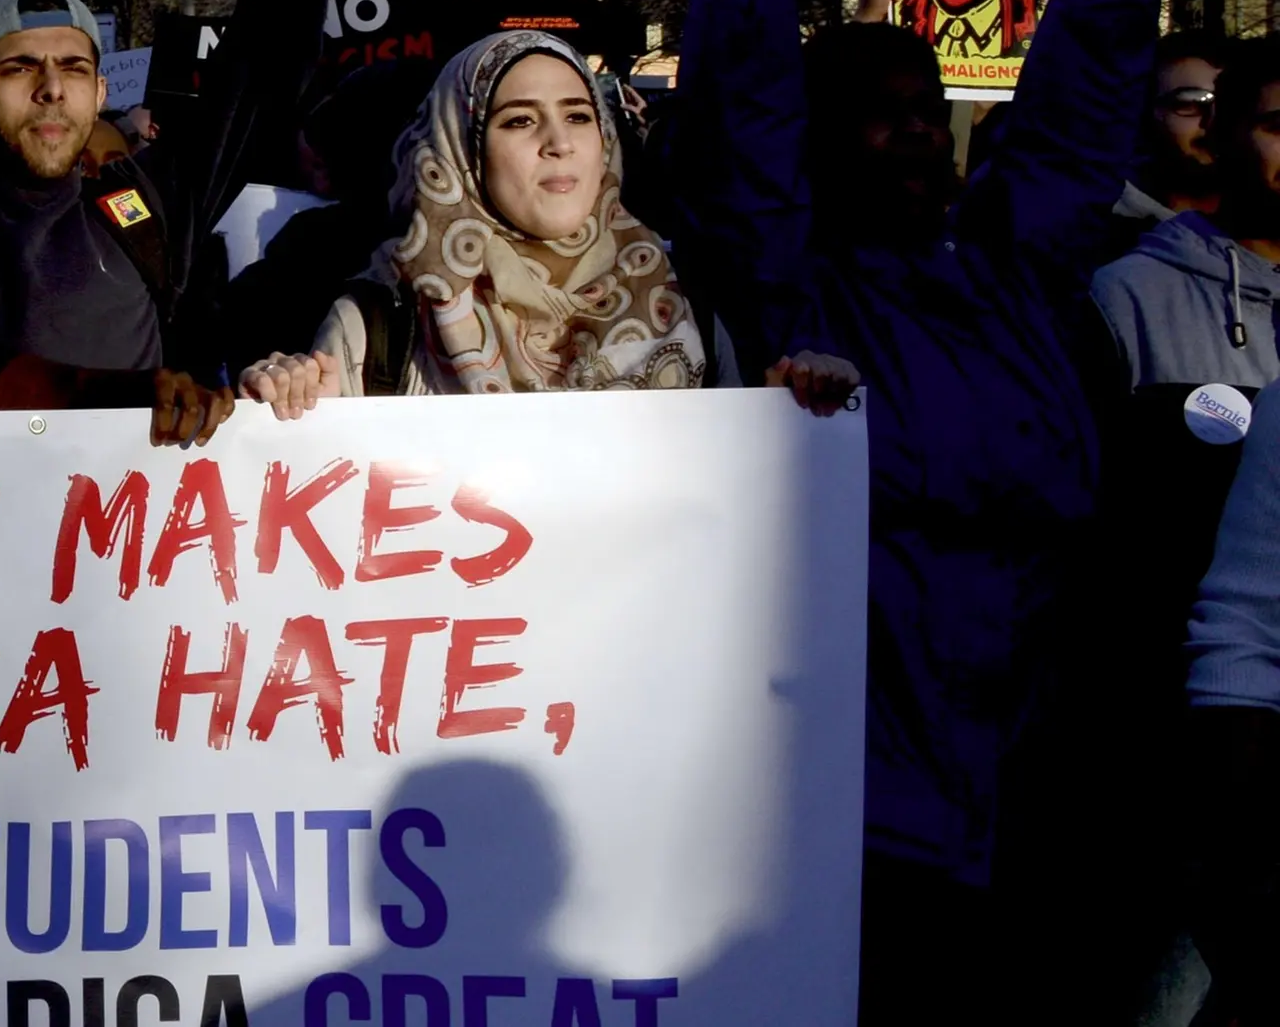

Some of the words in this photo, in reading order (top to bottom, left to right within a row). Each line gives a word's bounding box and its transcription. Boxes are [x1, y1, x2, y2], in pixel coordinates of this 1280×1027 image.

[1195, 391, 1247, 427] Bernie
[49, 457, 534, 604] MAKES
[154, 615, 576, 764] HATE,
